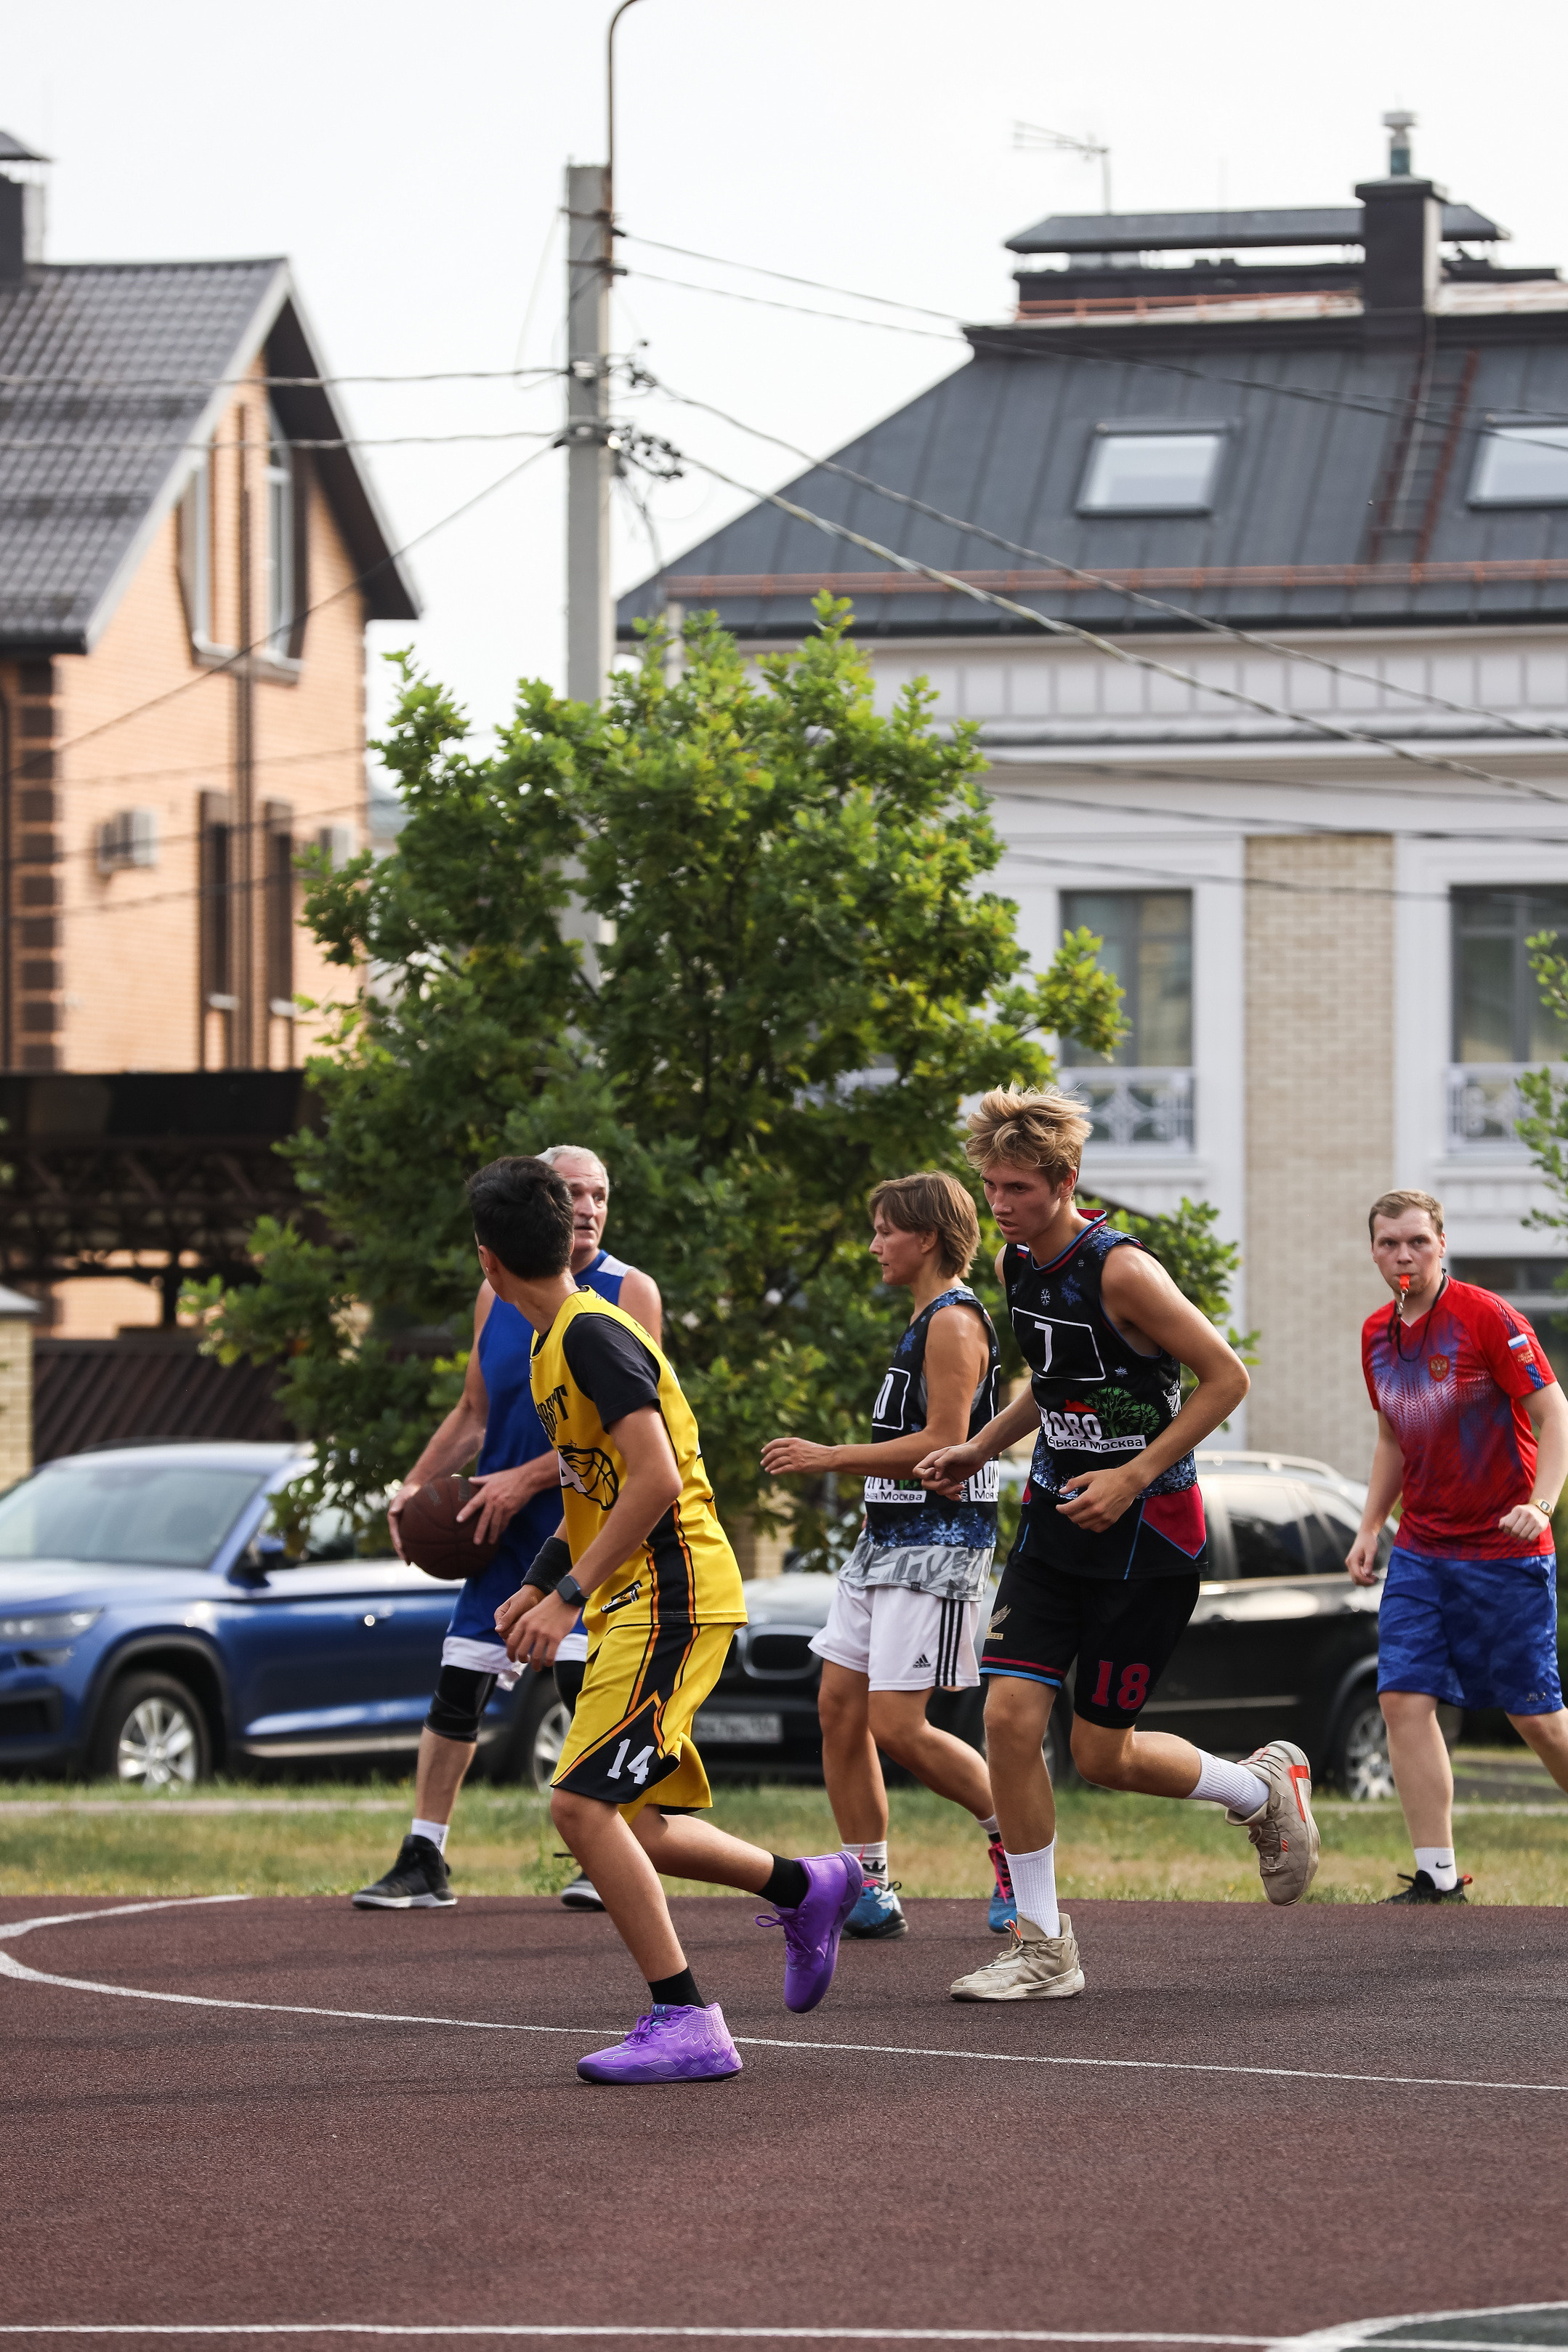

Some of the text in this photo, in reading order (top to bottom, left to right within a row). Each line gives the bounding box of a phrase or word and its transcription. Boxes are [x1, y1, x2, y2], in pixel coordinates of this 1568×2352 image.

[1034, 1321, 1053, 1372] 7
[1090, 1438, 1143, 1451] Москва
[881, 1491, 923, 1501] Москва
[1091, 1660, 1150, 1710] 18
[607, 1738, 655, 1785] 14
